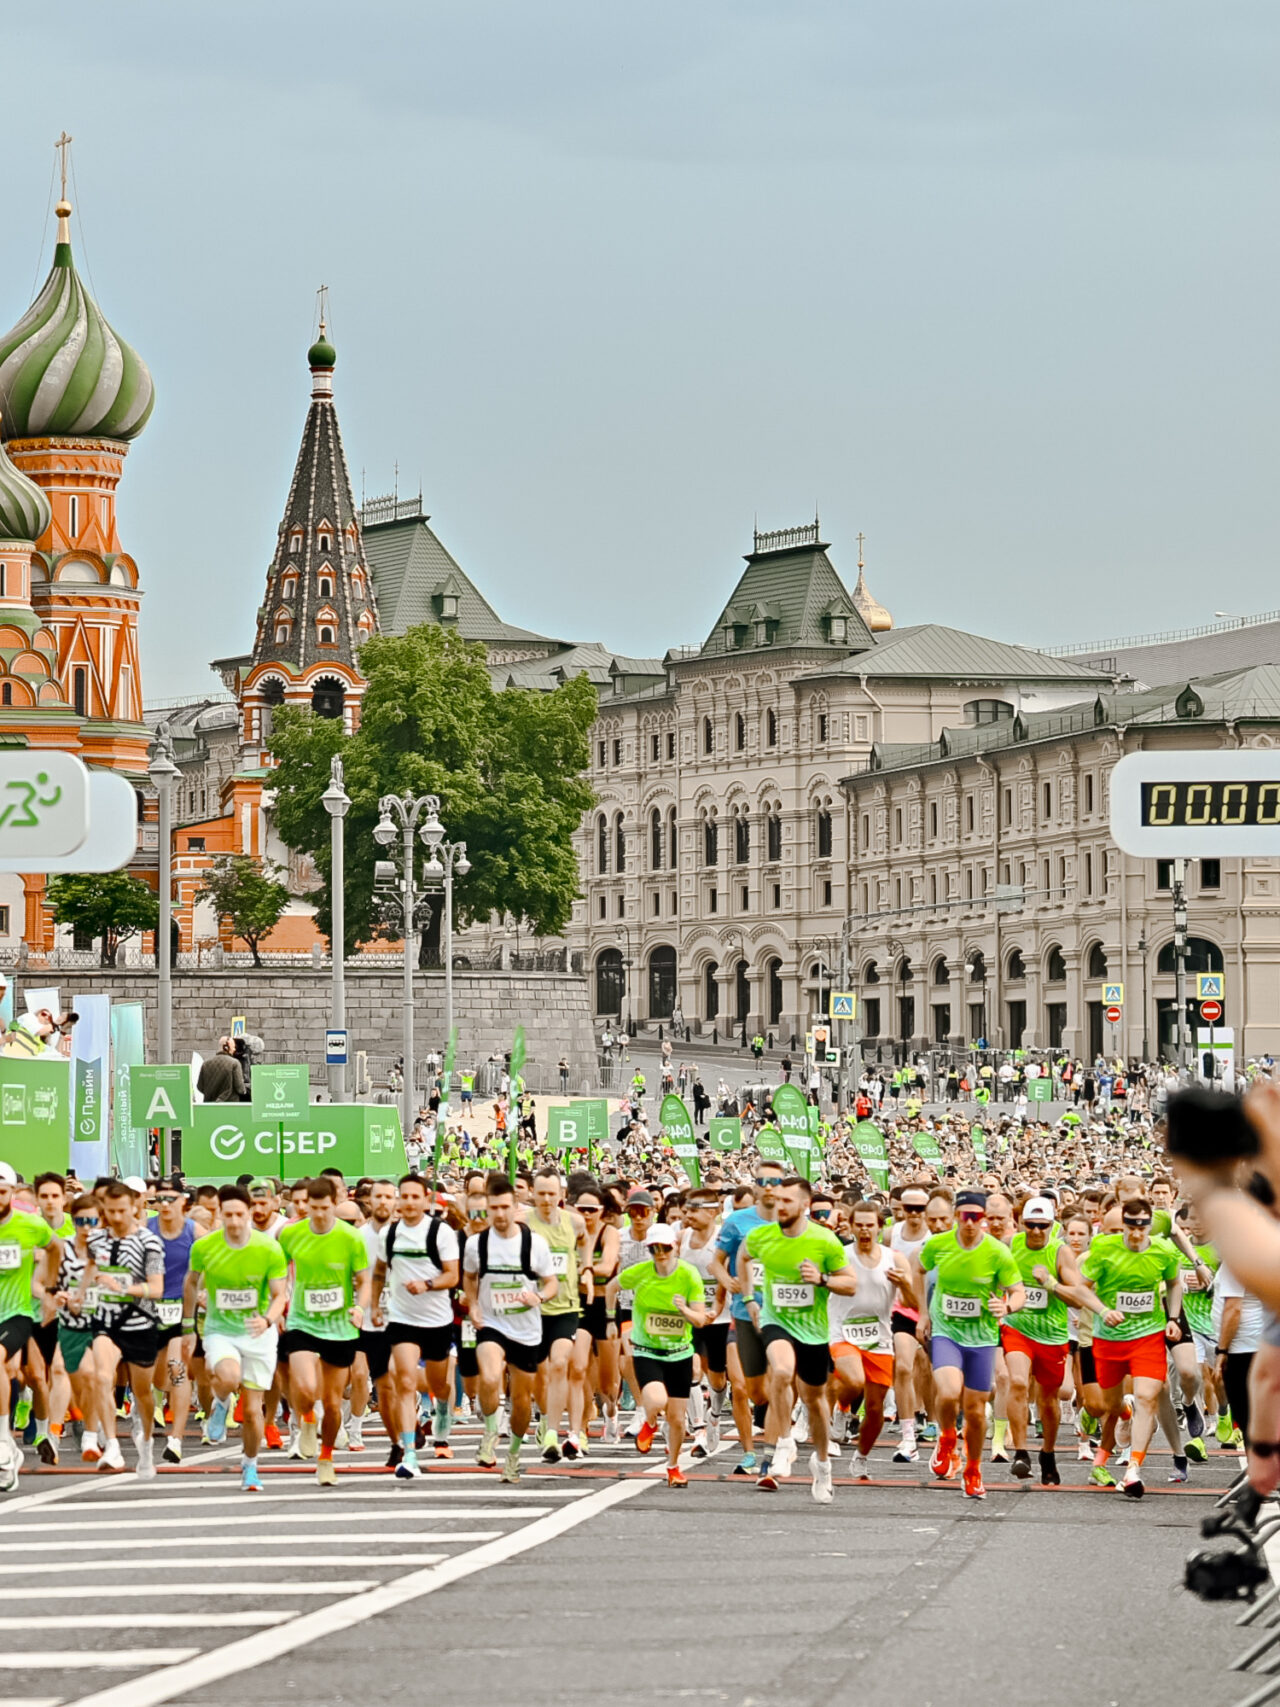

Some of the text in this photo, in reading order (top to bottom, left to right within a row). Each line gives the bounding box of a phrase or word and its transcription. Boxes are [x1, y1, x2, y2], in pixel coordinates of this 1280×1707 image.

[81, 1069, 94, 1116] Прайм
[254, 1132, 337, 1155] СБЕР
[222, 1293, 252, 1303] 7045
[310, 1292, 338, 1305] 8303
[777, 1288, 808, 1300] 8596
[947, 1299, 975, 1311] 8120
[1119, 1295, 1153, 1307] 10662
[649, 1316, 684, 1329] 10860
[845, 1326, 879, 1338] 10156
